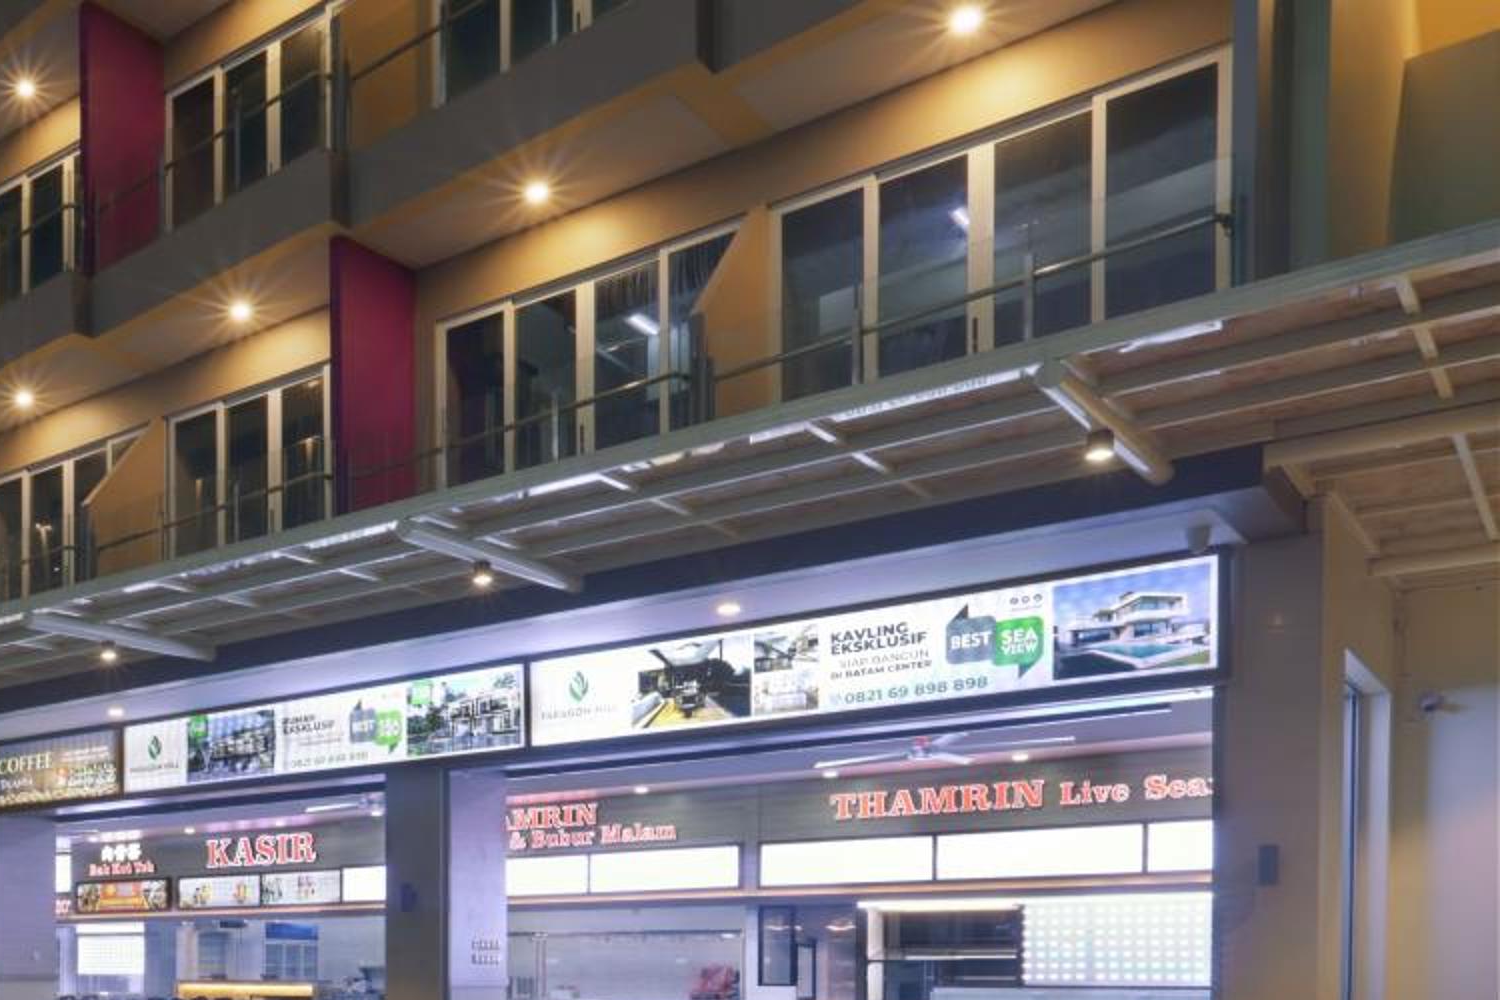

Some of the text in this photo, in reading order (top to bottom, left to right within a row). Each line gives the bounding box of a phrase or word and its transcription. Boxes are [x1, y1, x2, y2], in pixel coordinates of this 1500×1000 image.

[831, 622, 908, 643] KAVLING
[831, 632, 927, 655] EKSKLUSIF
[950, 632, 992, 649] BEST
[1001, 628, 1038, 645] SEA
[845, 667, 885, 679] BATAM
[888, 660, 933, 673] CENTER
[844, 676, 988, 704] 0821 69 898 898
[830, 774, 1213, 819] THAMRIN Live Sea
[531, 829, 596, 848] Bubur
[600, 823, 677, 844] Malam
[206, 832, 317, 868] KASIR
